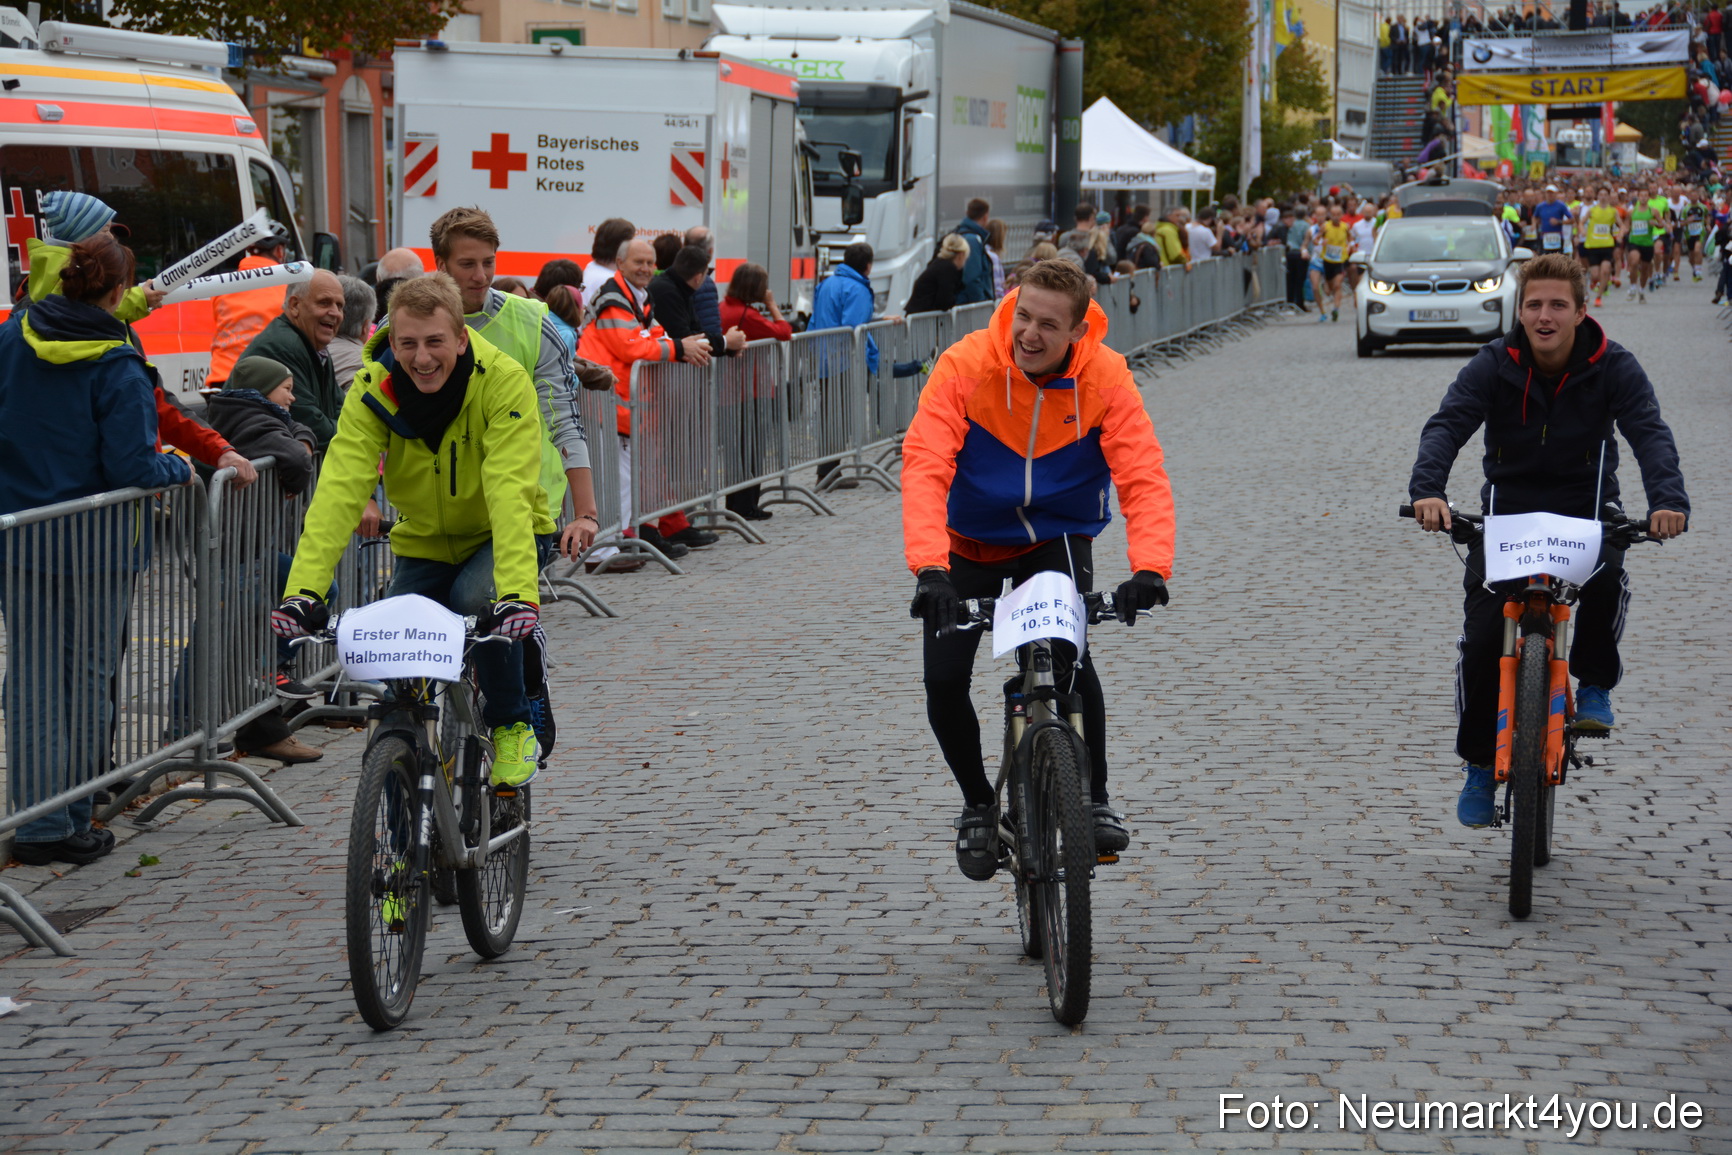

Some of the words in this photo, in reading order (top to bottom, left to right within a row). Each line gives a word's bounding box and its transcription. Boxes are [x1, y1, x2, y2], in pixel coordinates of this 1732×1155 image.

[1531, 77, 1609, 97] START
[537, 134, 639, 153] Bayerisches
[537, 155, 584, 171] Rotes
[536, 177, 584, 192] Kreuz
[1088, 170, 1156, 185] Laufsport
[161, 222, 257, 287] bmw-laufsport.de
[1499, 539, 1543, 552] Erster
[1547, 537, 1586, 550] Mann
[1516, 553, 1544, 566] 10,5
[1549, 553, 1570, 566] km
[1011, 601, 1048, 621] Erste
[1054, 599, 1080, 623] Frau
[1020, 616, 1051, 632] 10,5
[1056, 616, 1076, 633] km
[352, 628, 400, 641] Erster
[404, 628, 447, 641] Mann
[345, 650, 453, 664] Halbmarathon
